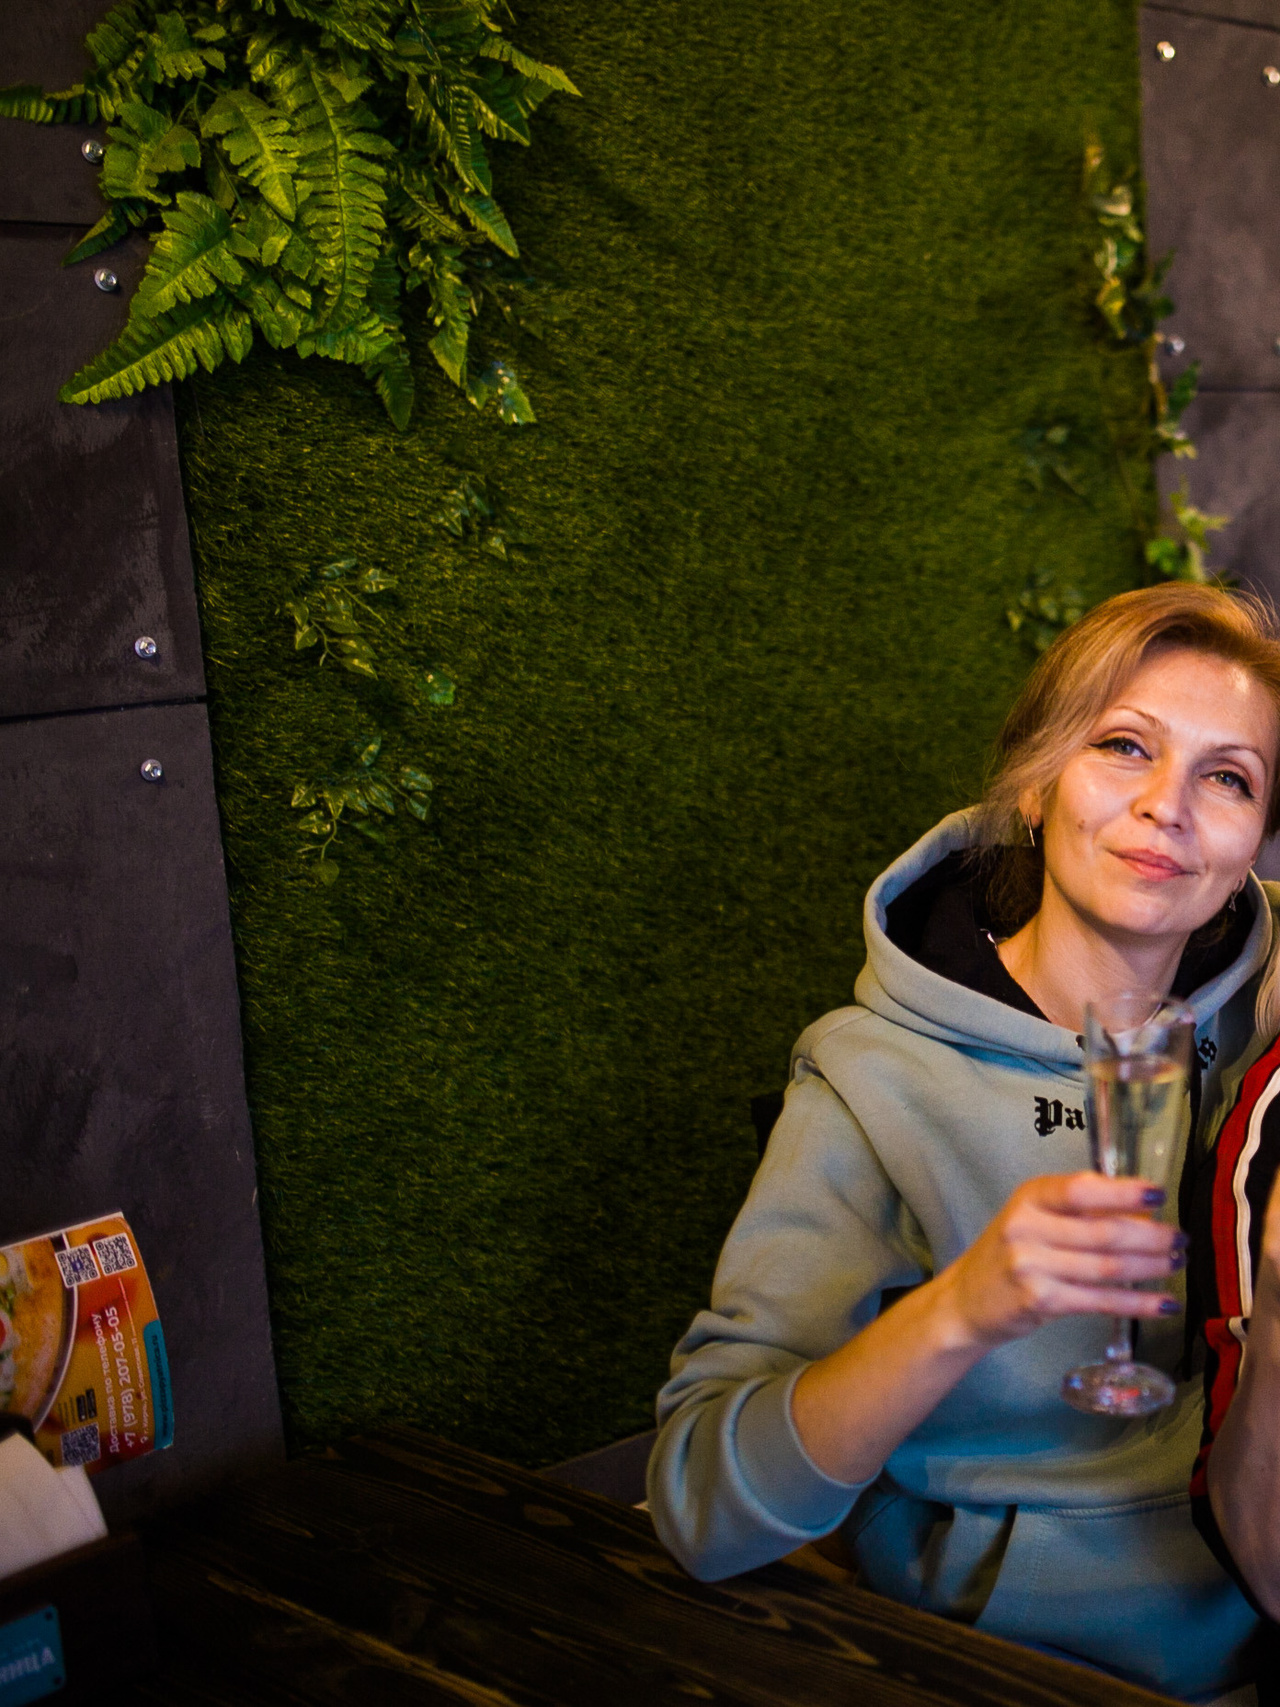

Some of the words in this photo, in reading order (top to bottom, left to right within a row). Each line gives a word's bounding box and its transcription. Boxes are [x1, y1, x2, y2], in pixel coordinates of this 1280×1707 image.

[92, 1313, 110, 1376] телефону
[105, 1306, 131, 1386] 207-05-05
[105, 1377, 114, 1394] по
[121, 1388, 138, 1427] (978)
[107, 1396, 121, 1453] Доставка
[124, 1431, 136, 1448] +7
